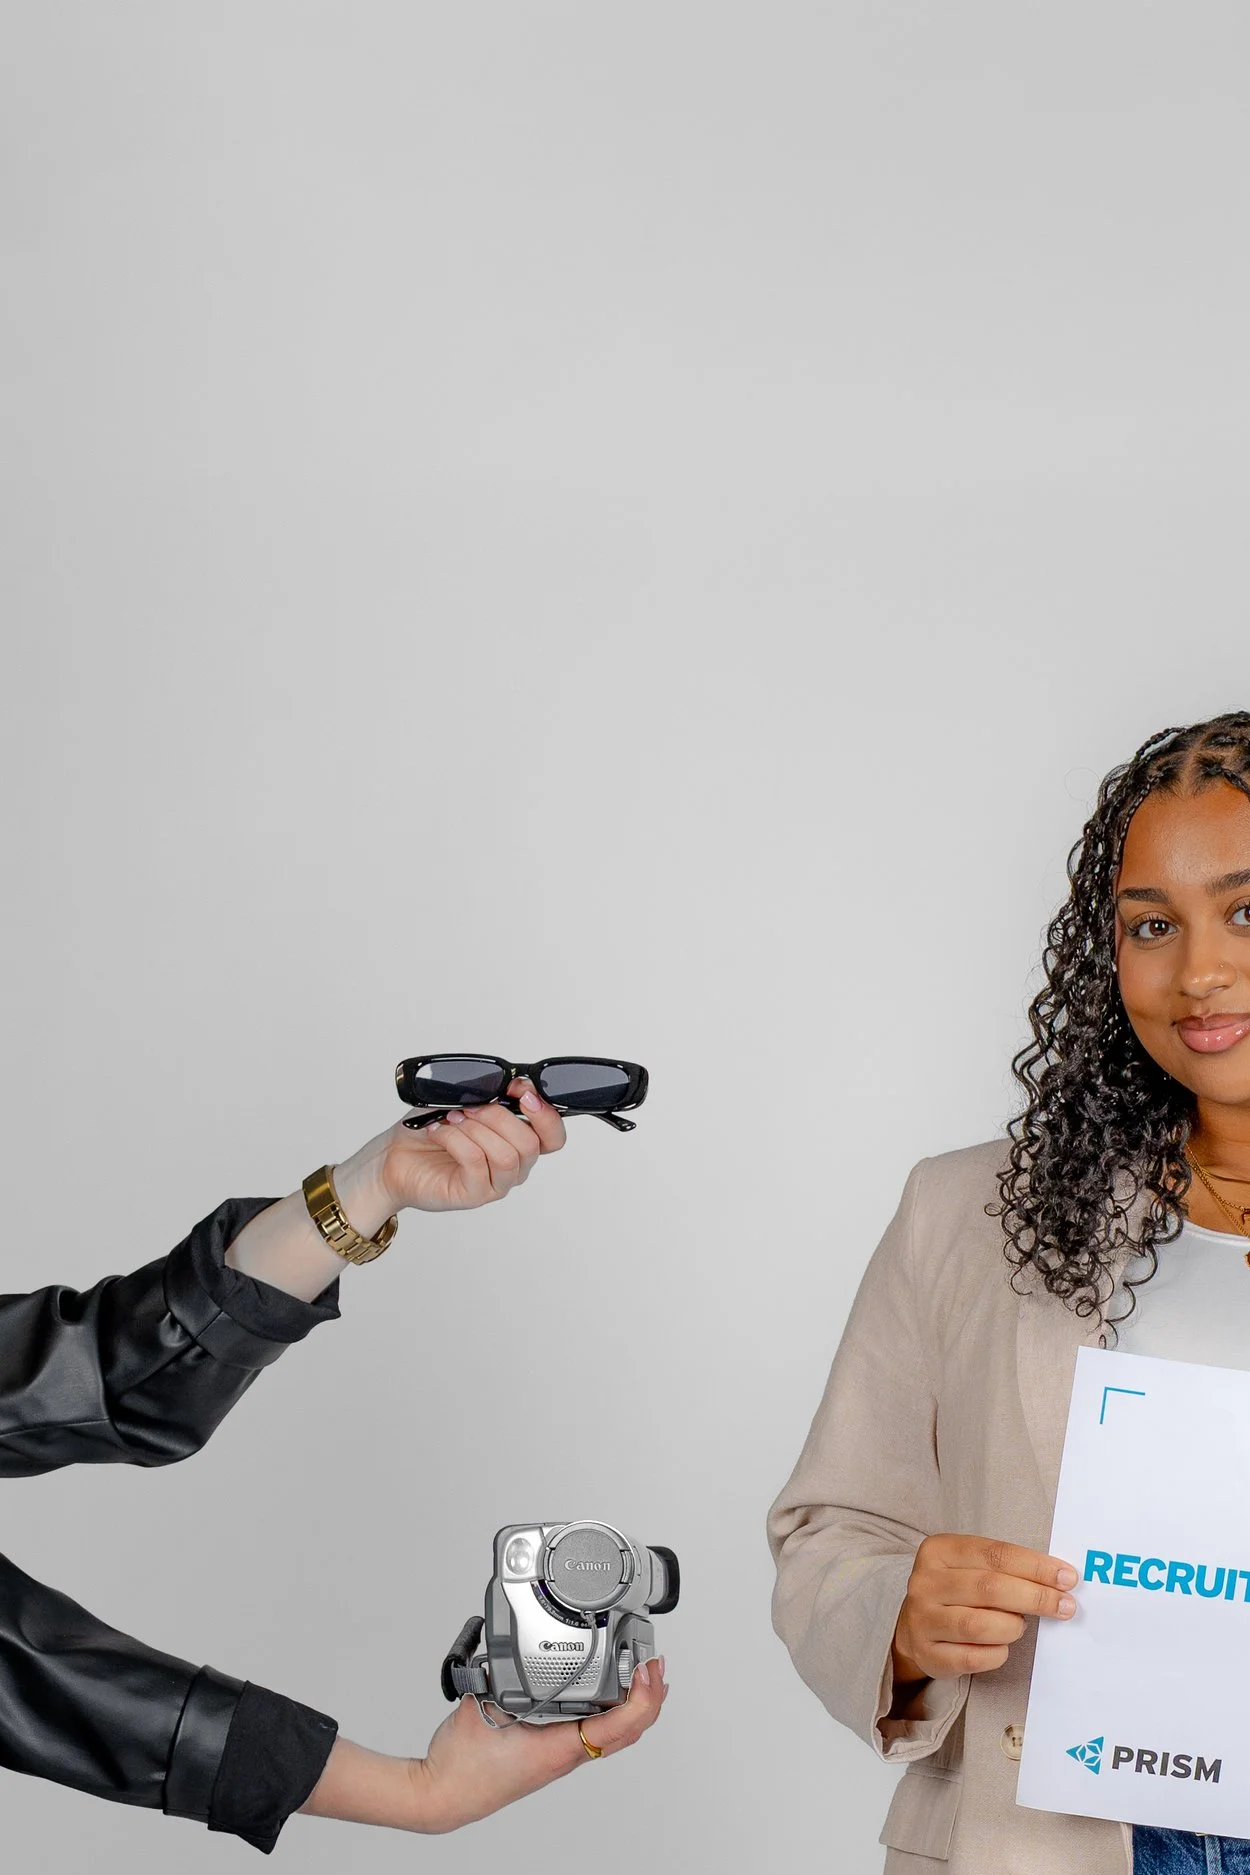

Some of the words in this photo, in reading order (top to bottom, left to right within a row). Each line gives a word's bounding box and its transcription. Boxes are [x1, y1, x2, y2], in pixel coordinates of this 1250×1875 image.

[564, 1559, 612, 1571] Canon
[539, 1640, 584, 1651] Canon
[1111, 1745, 1223, 1784] PRISM
